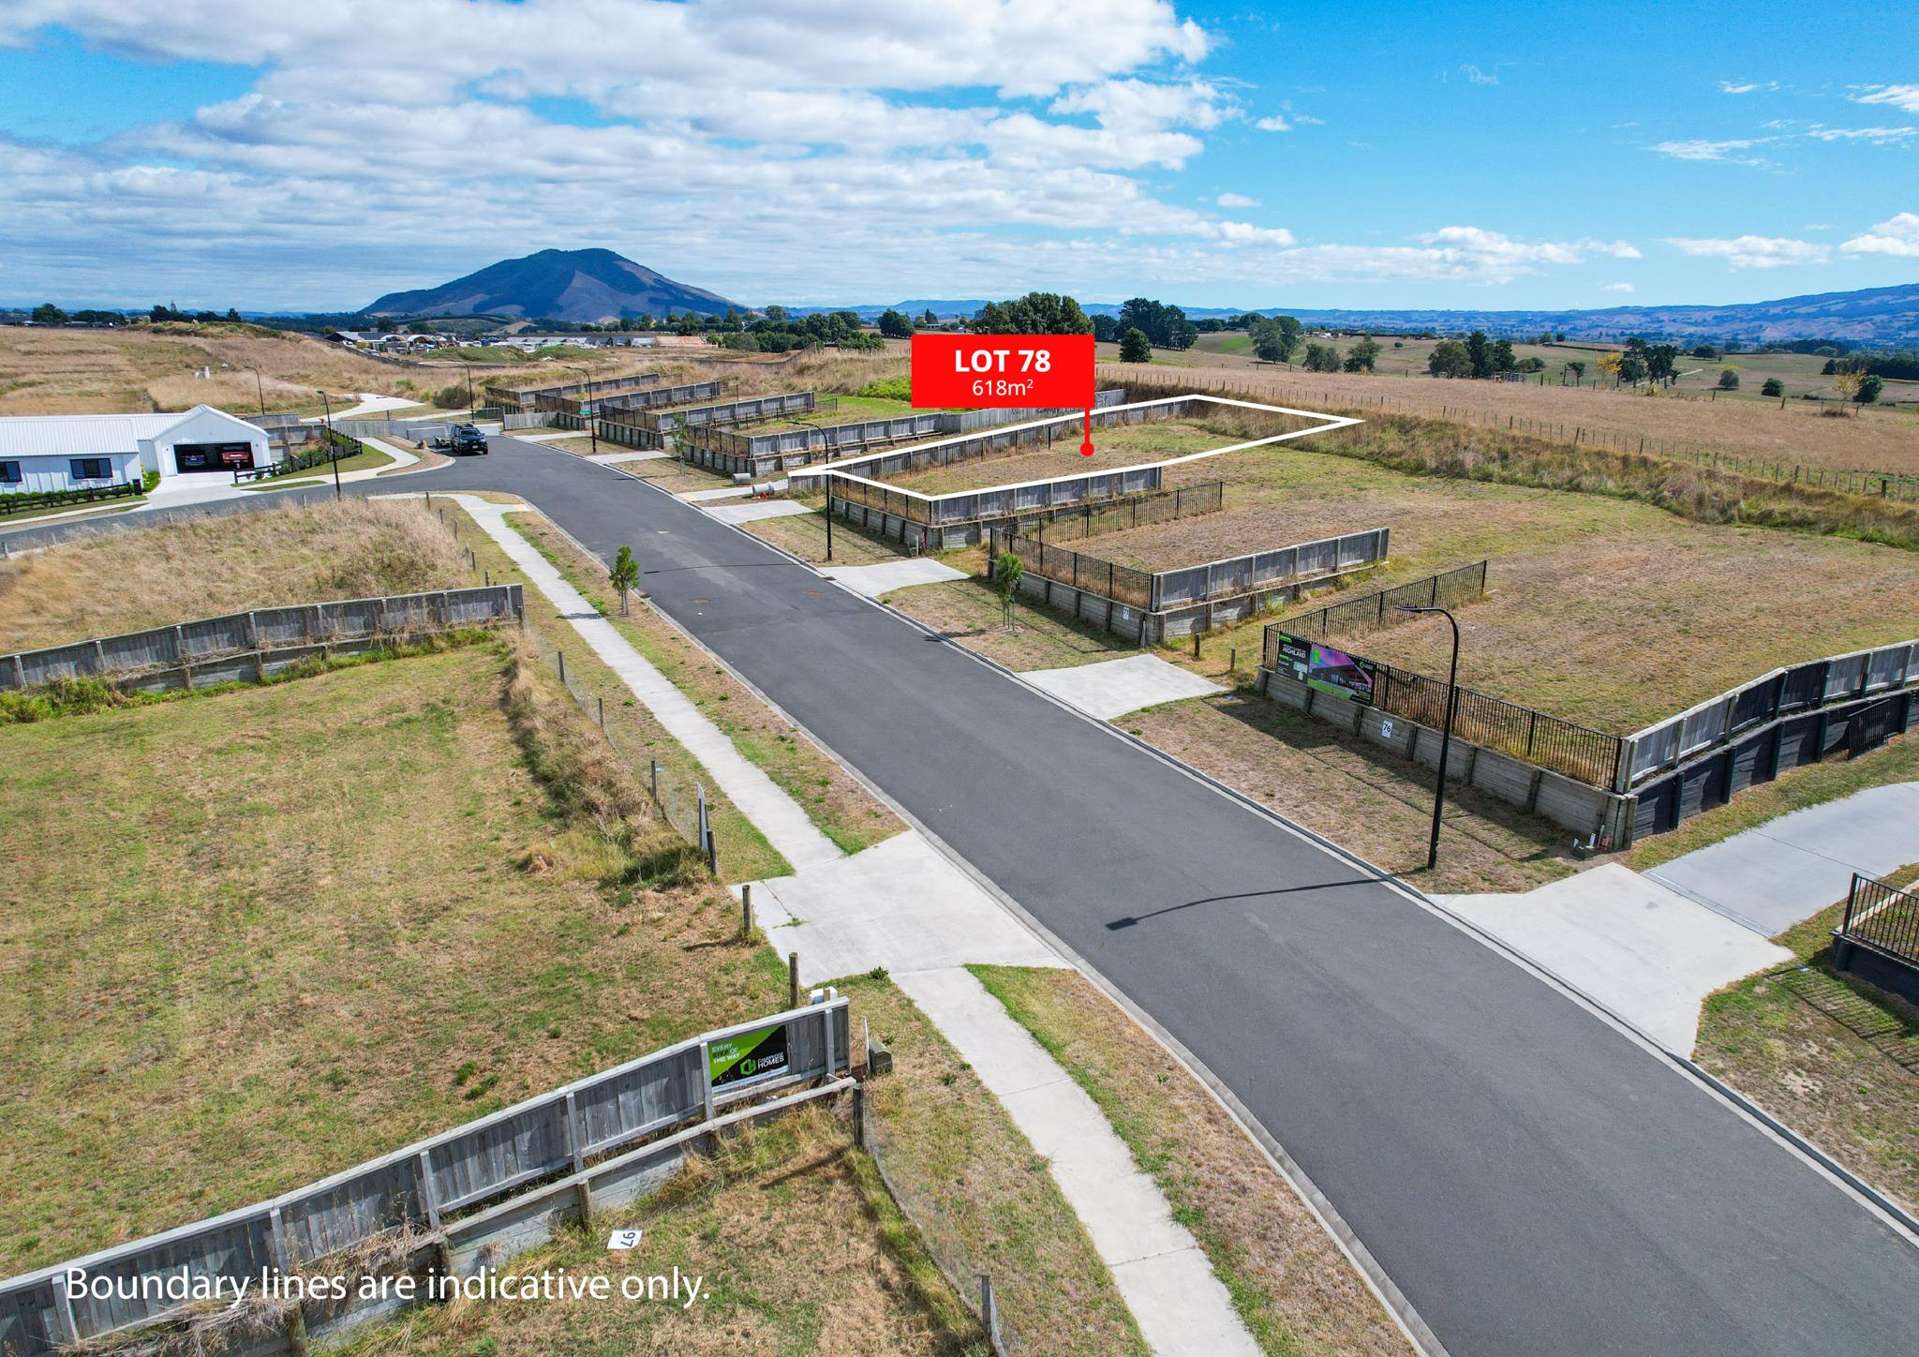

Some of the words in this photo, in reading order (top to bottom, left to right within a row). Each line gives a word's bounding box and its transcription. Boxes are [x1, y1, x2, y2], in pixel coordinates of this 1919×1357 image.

[1383, 723, 1391, 733] 76
[757, 1055, 785, 1069] HOMES
[620, 1231, 637, 1248] 97
